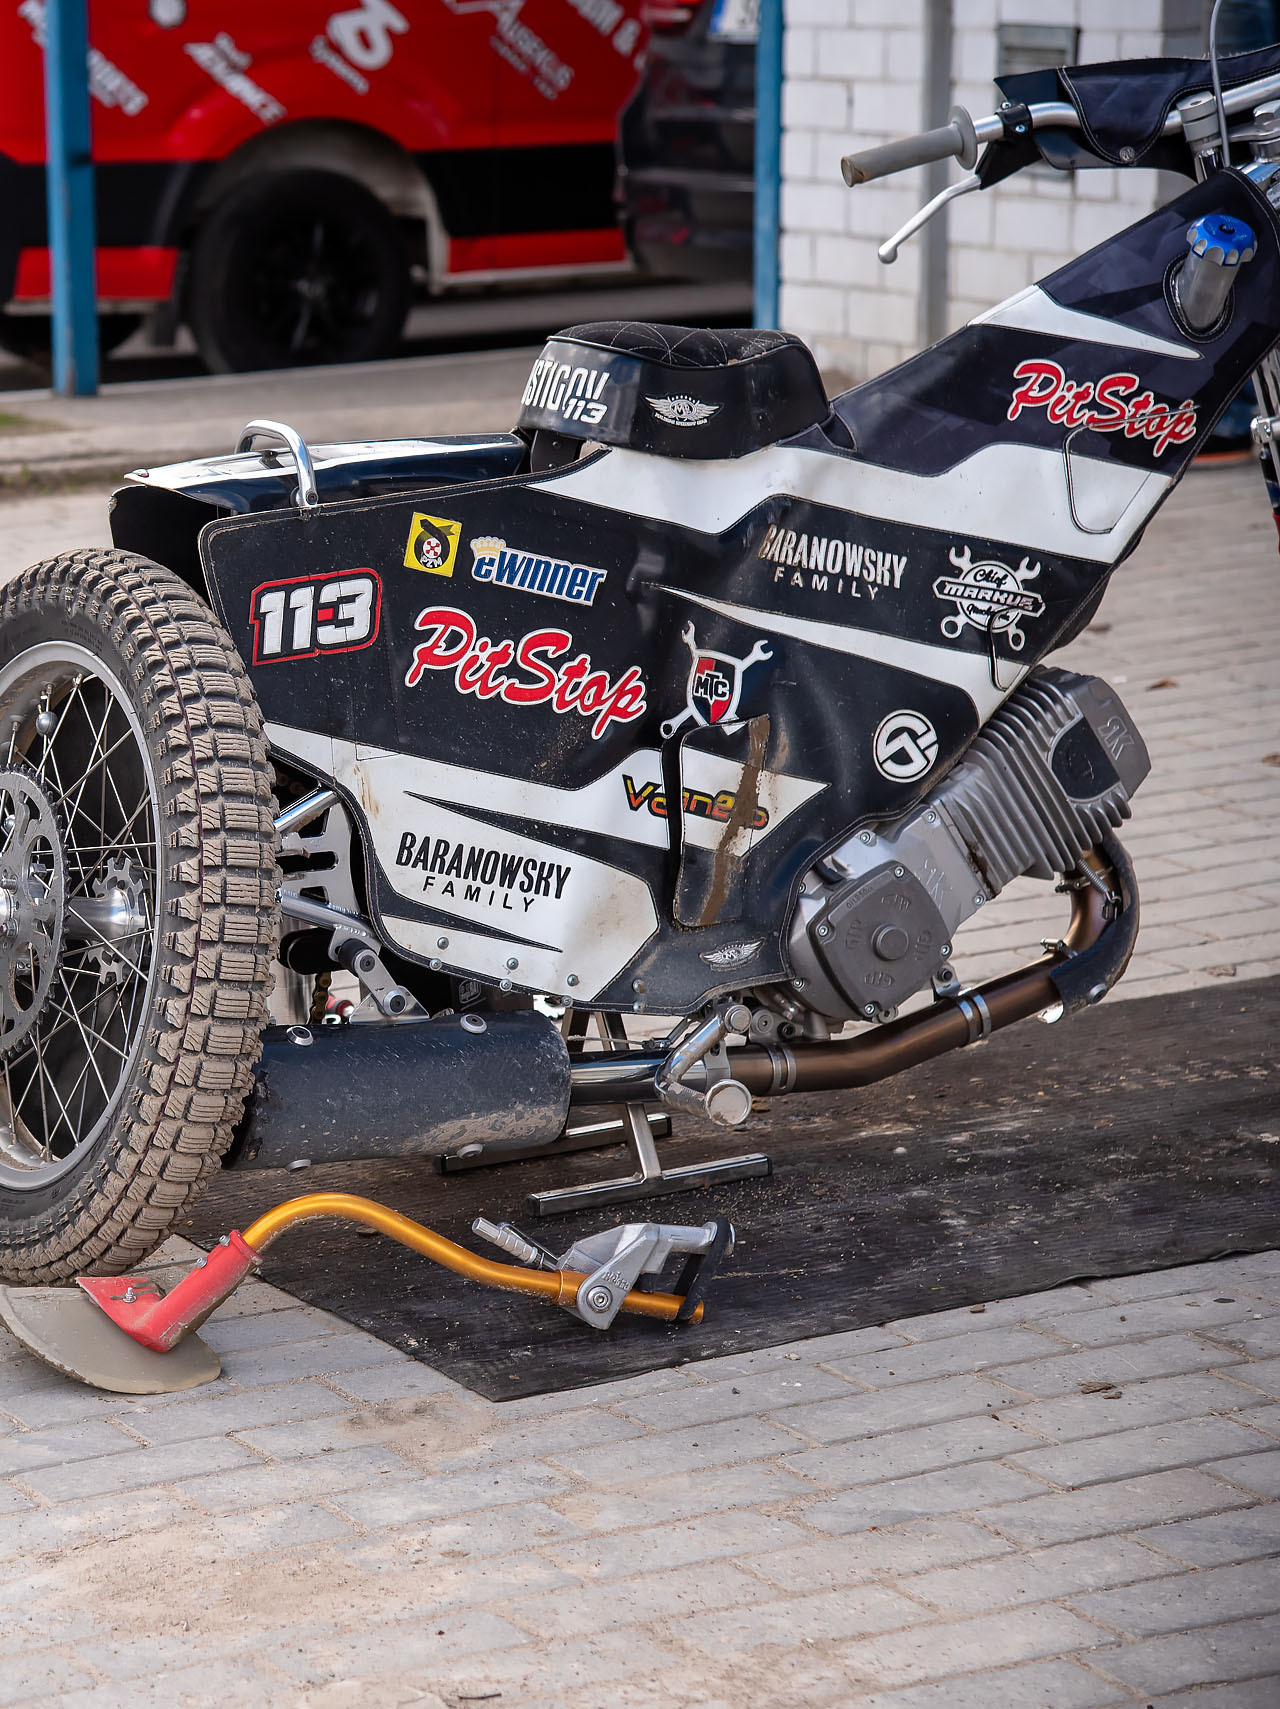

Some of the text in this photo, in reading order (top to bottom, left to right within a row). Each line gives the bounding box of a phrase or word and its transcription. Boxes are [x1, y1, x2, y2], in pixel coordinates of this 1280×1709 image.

[563, 398, 608, 424] 113
[1007, 358, 1196, 458] PitStop
[474, 547, 606, 604] eWinner
[758, 523, 908, 589] BARANOWSKY
[774, 566, 878, 600] FAMILY
[259, 578, 373, 655] 113
[404, 605, 647, 740] PitStop
[694, 671, 729, 702] MTC
[395, 831, 573, 900] BARANOWSKY
[422, 875, 536, 913] FAMILY
